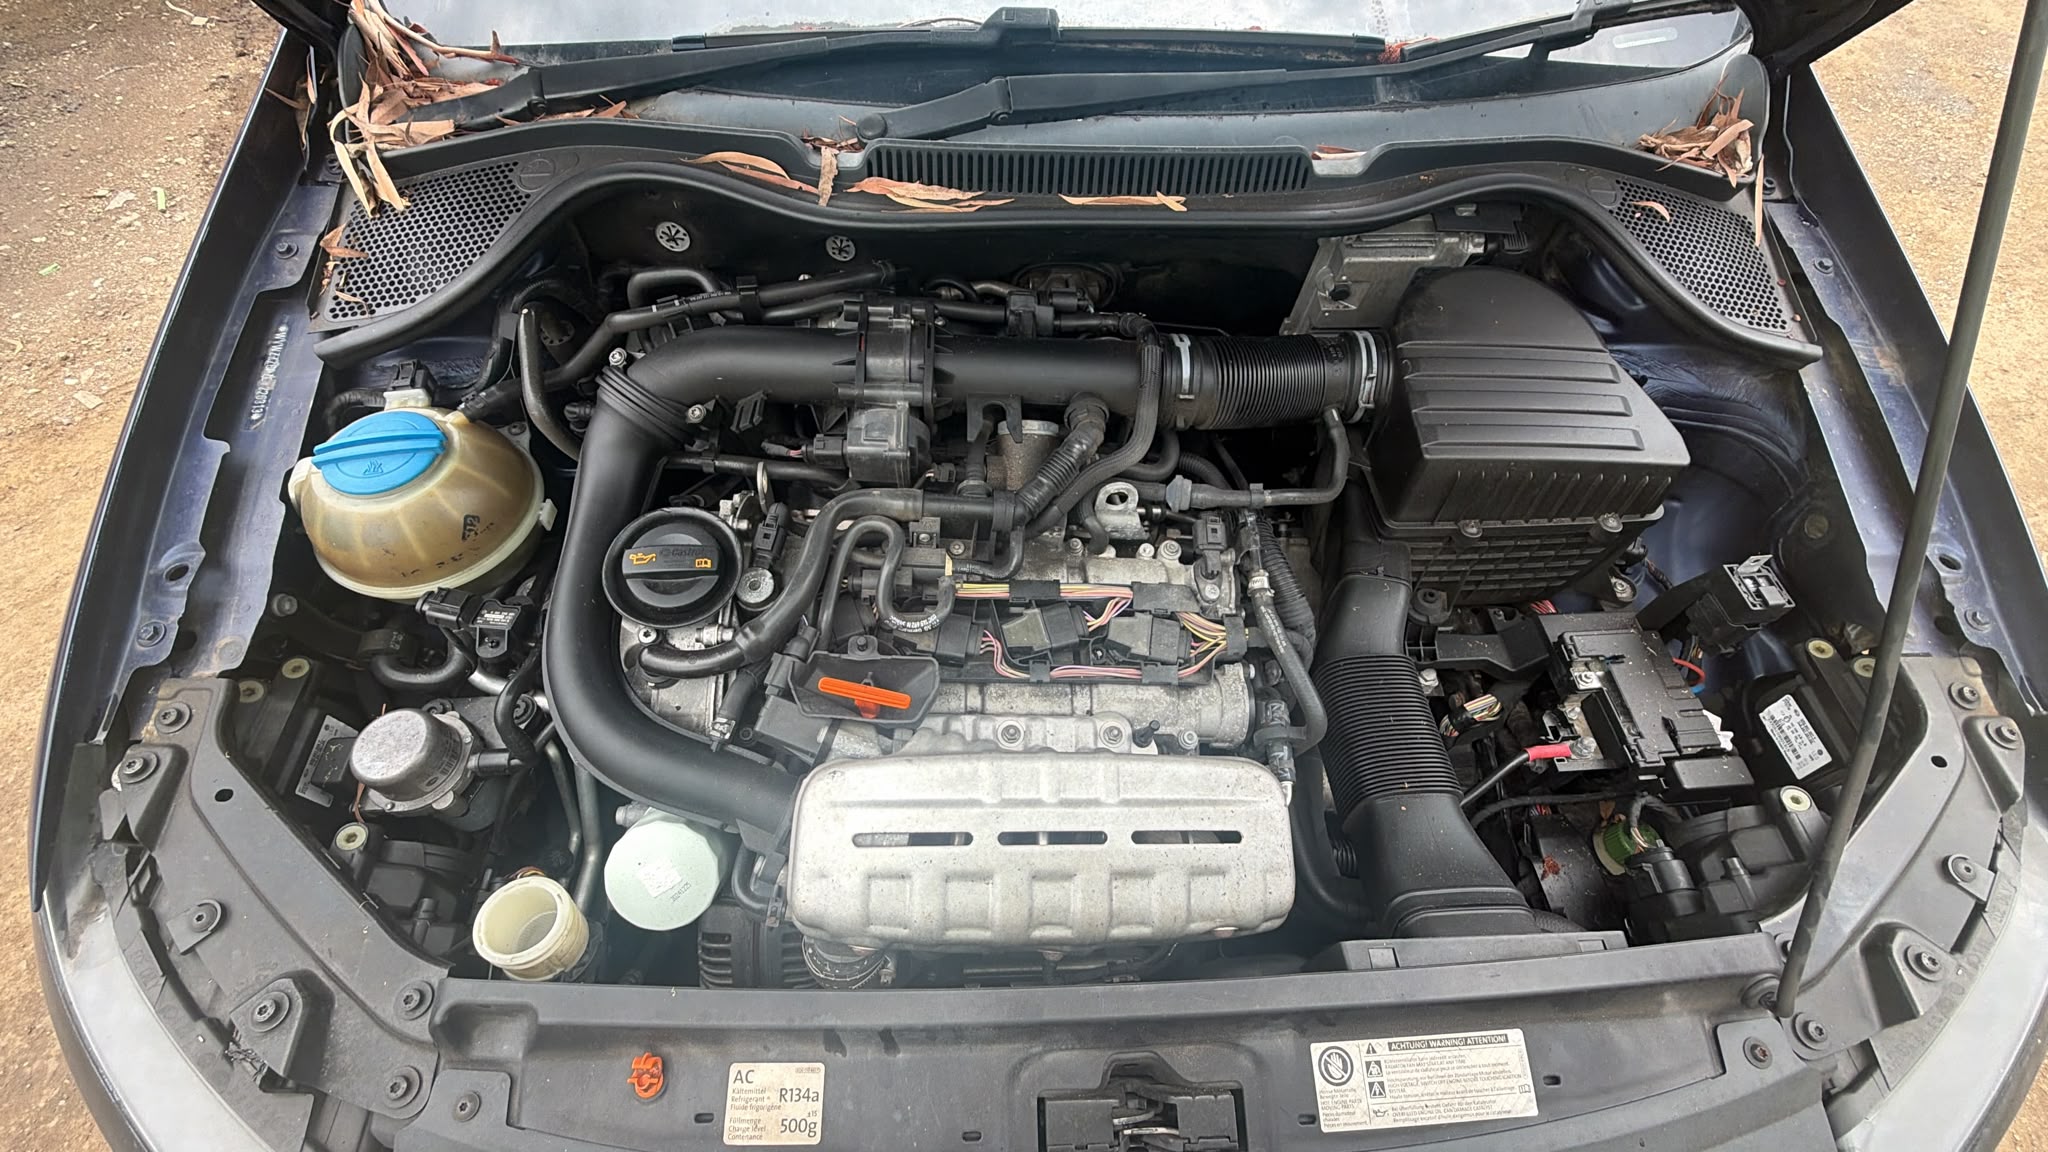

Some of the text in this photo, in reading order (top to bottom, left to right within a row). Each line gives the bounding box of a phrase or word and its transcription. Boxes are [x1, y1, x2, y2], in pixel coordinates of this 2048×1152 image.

[1390, 1034, 1506, 1050] ACHTUNG! WARNING! ATTENTION!
[733, 1069, 755, 1084] AC
[731, 1095, 765, 1105] Refrigerant
[779, 1087, 820, 1103] R134a
[728, 1125, 767, 1134] Charge level
[780, 1118, 818, 1138] 500g
